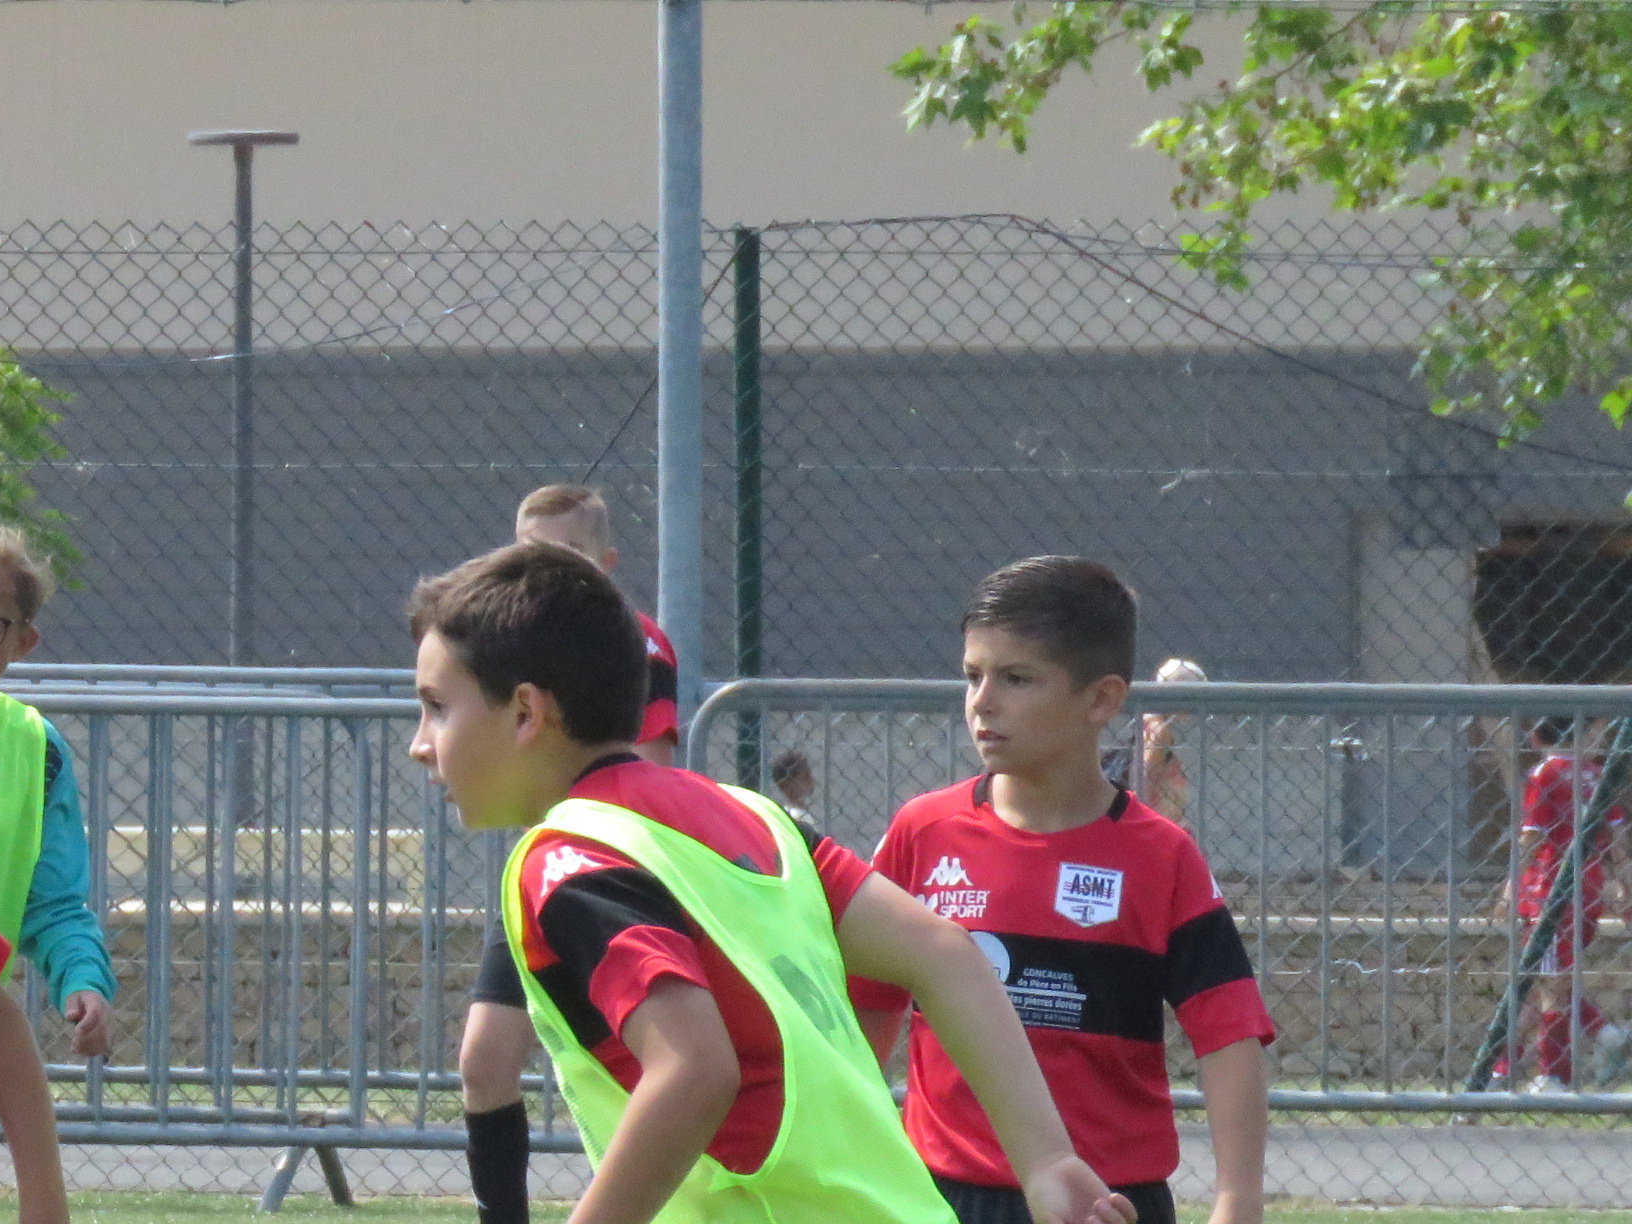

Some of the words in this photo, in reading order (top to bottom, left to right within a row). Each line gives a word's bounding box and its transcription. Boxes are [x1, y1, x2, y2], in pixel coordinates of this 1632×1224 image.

[1070, 873, 1115, 900] ASMT
[940, 890, 989, 904] INTER
[939, 904, 987, 918] SPORT
